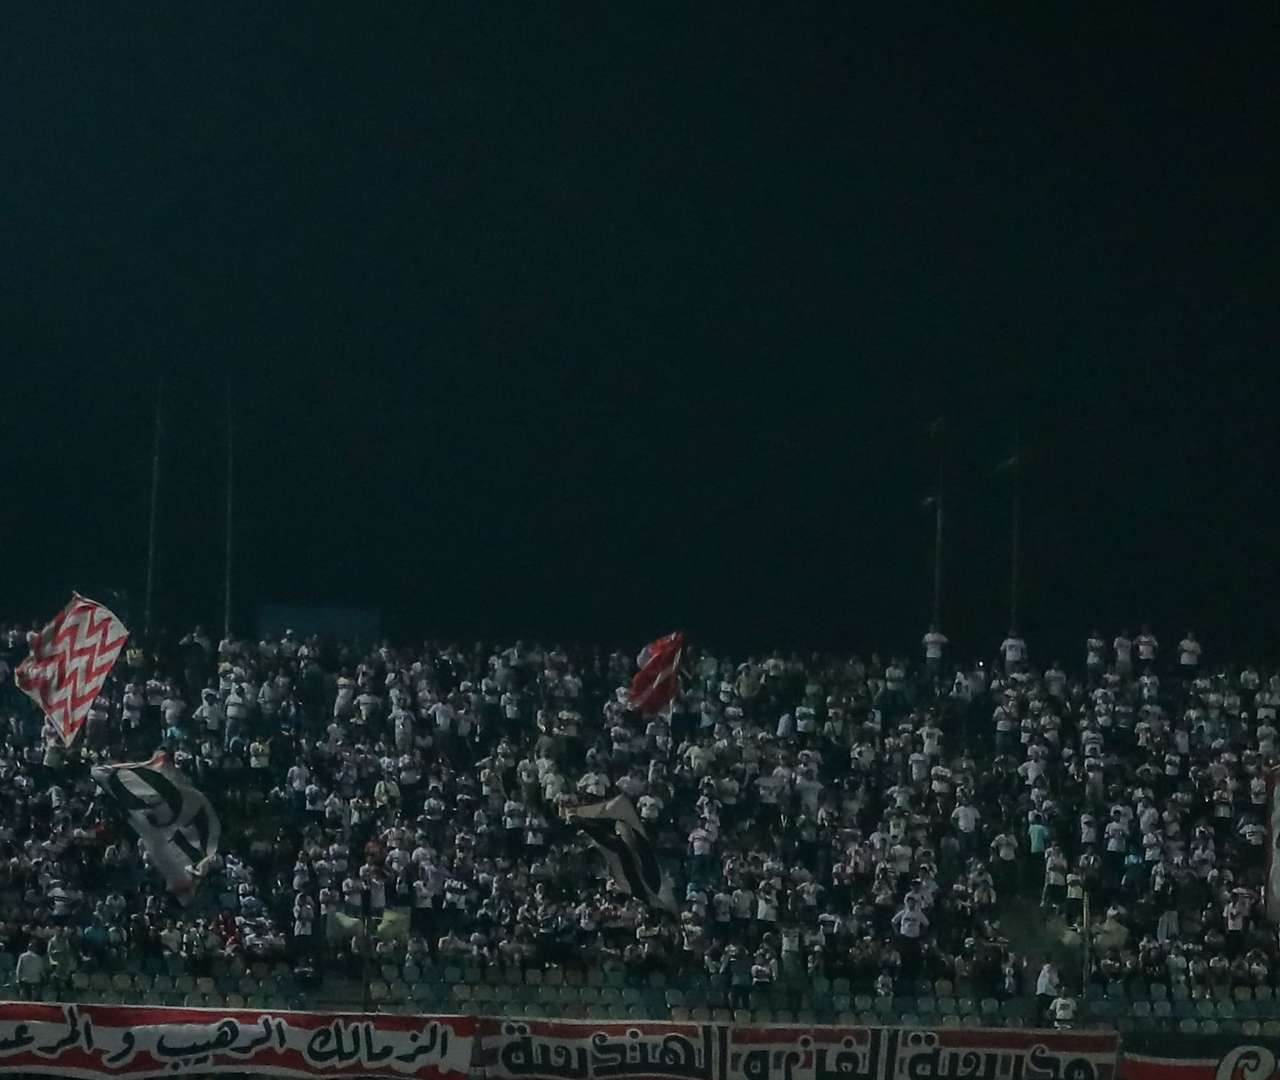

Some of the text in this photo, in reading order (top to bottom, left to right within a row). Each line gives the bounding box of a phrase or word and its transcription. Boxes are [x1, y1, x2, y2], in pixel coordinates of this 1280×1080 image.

[0, 1004, 94, 1054] المرع
[156, 1018, 286, 1071] الرهيب
[307, 1022, 448, 1062] الزمالك
